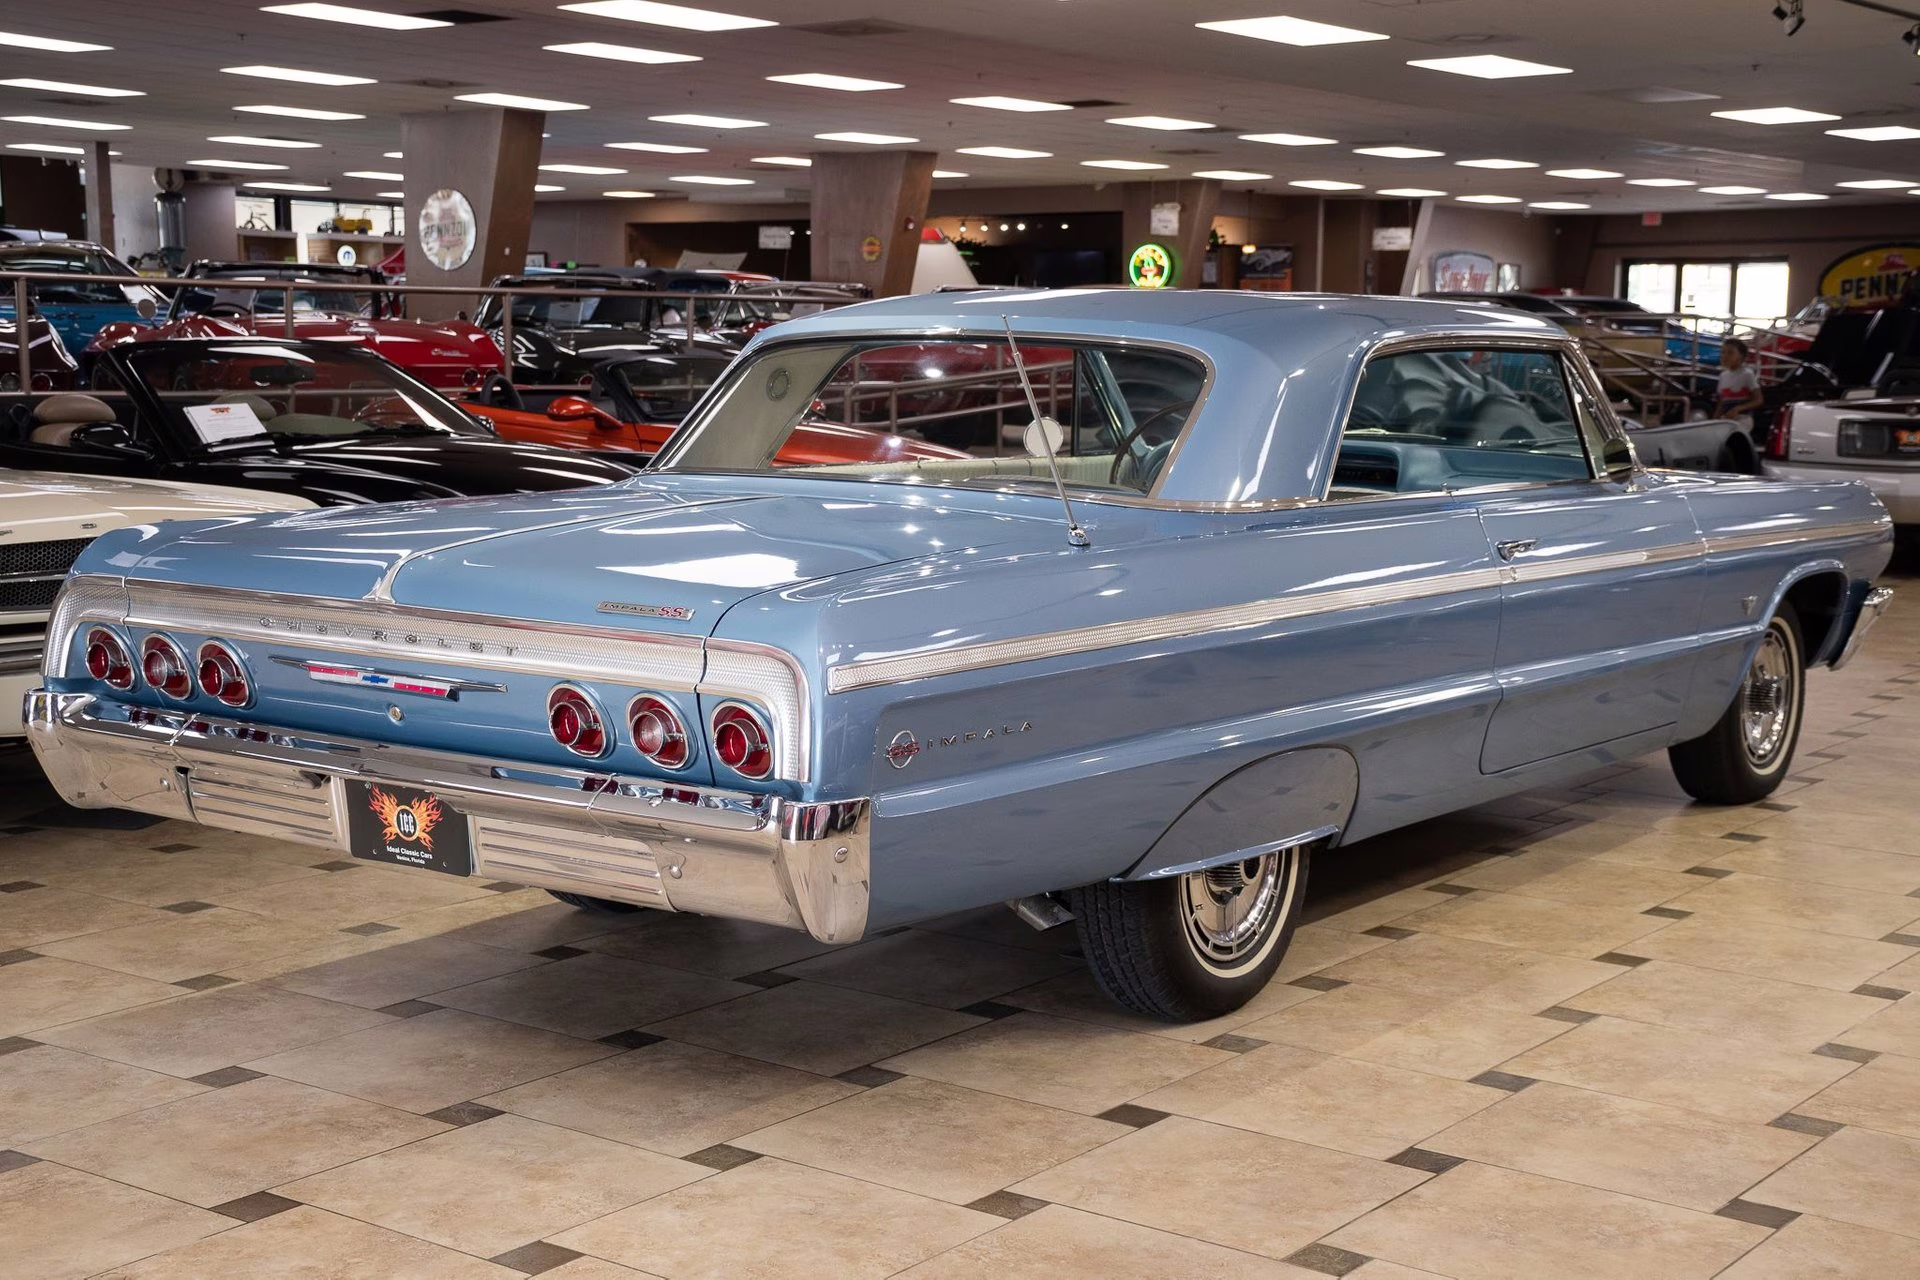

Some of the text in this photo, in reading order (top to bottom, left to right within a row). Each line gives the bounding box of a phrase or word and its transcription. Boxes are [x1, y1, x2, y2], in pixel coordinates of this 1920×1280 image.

[423, 220, 467, 239] PENNZOI
[1841, 272, 1909, 299] PENN
[604, 603, 684, 618] IMPALA SS
[259, 616, 519, 656] CHEVROLET
[927, 721, 1032, 750] IMPALA
[399, 812, 416, 834] ICC
[386, 845, 433, 860] Ideal Classic Cars
[411, 857, 426, 865] Florida
